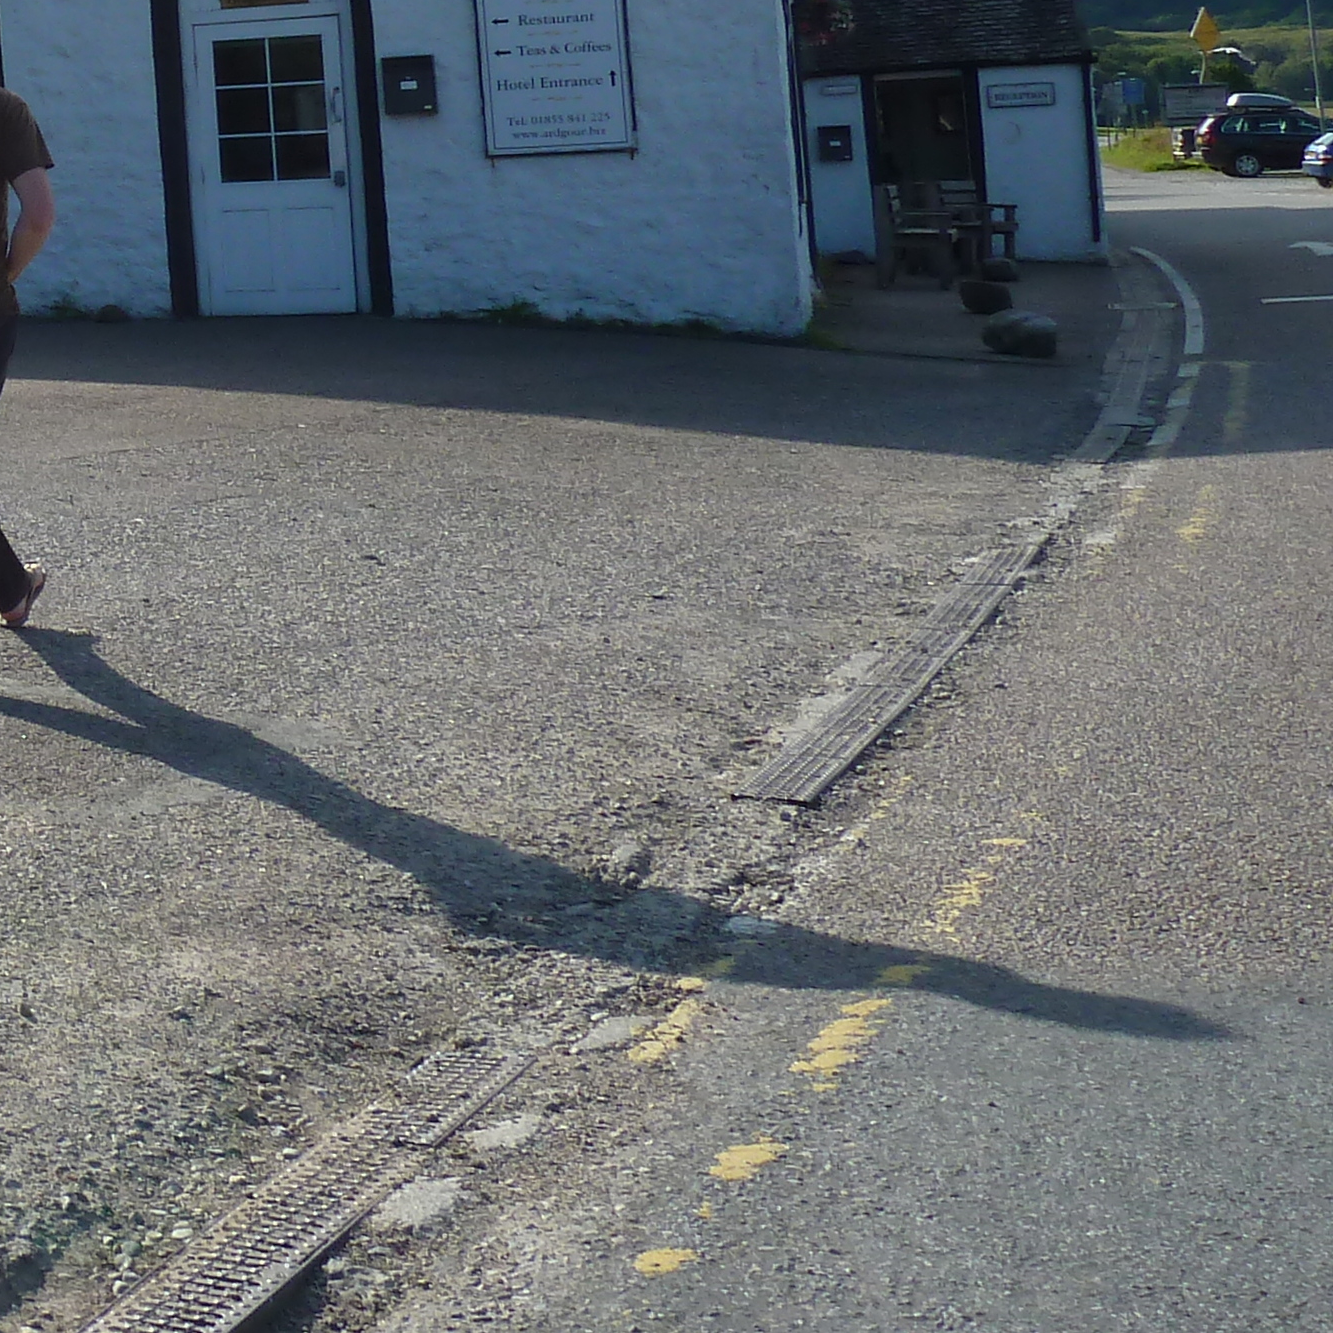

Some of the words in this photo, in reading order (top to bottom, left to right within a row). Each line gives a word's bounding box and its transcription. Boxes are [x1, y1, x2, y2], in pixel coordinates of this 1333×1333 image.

[517, 13, 595, 26] Restaurant
[517, 45, 546, 57] Teas
[549, 44, 561, 55] &
[564, 41, 612, 54] Coffees
[496, 78, 535, 91] Hotel
[540, 76, 604, 89] Entrance
